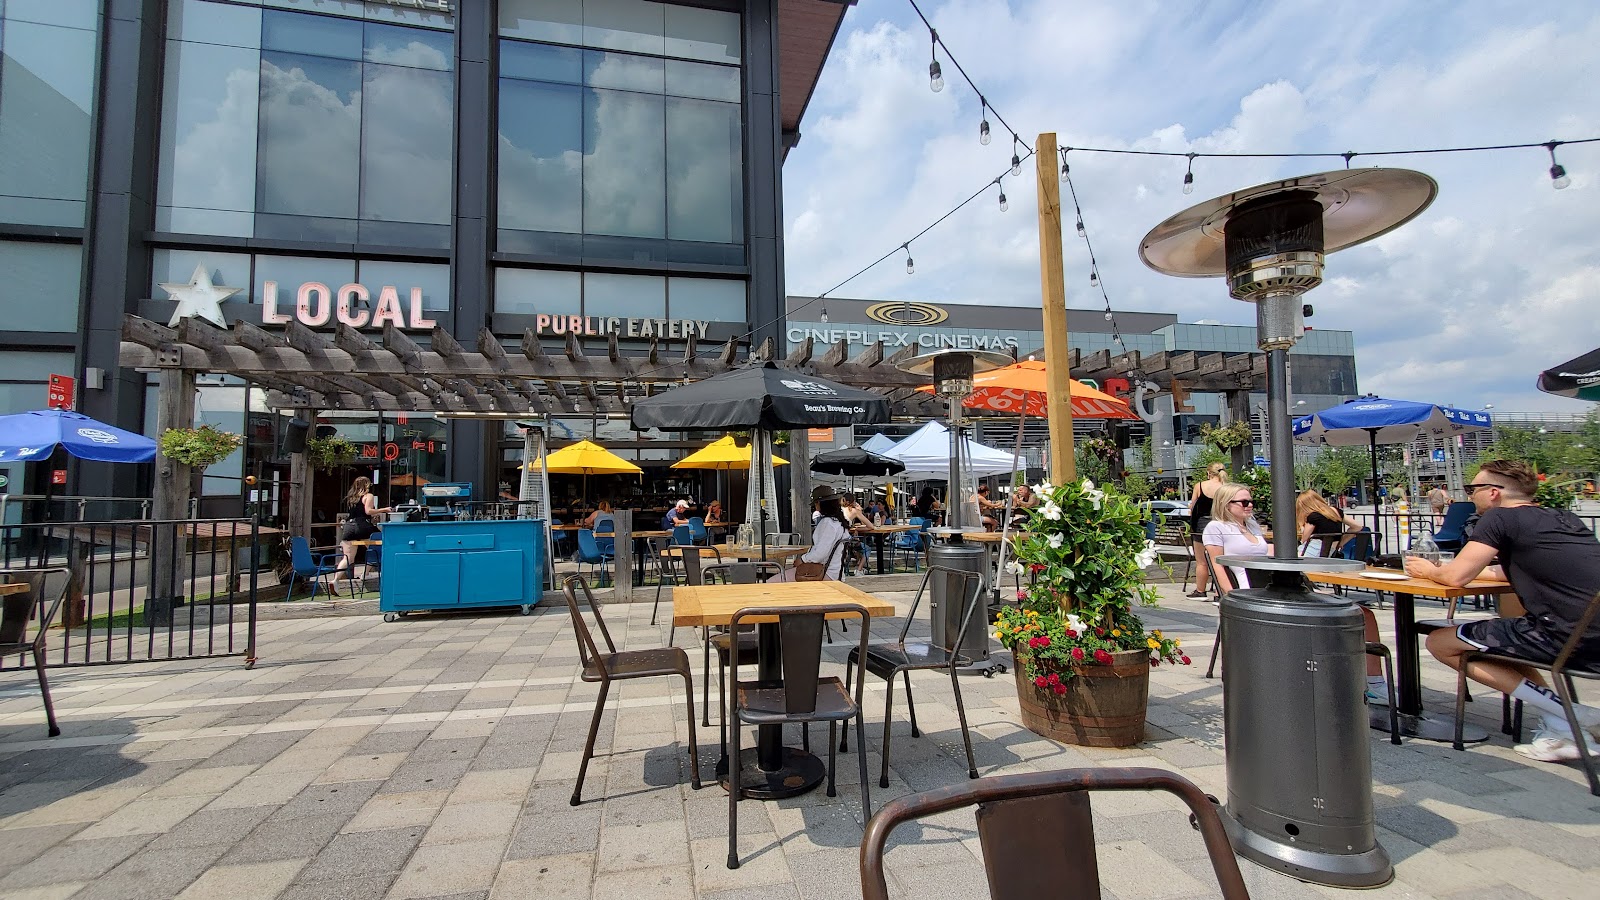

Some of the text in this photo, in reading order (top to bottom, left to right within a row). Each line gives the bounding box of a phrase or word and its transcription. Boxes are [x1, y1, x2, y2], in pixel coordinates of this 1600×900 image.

[263, 280, 437, 328] LOCAL
[536, 313, 709, 339] PUBLIC EATERY
[786, 328, 1018, 350] CINEPLEX CINEMAS
[804, 404, 826, 412] Beau's
[826, 404, 853, 414] Brewing
